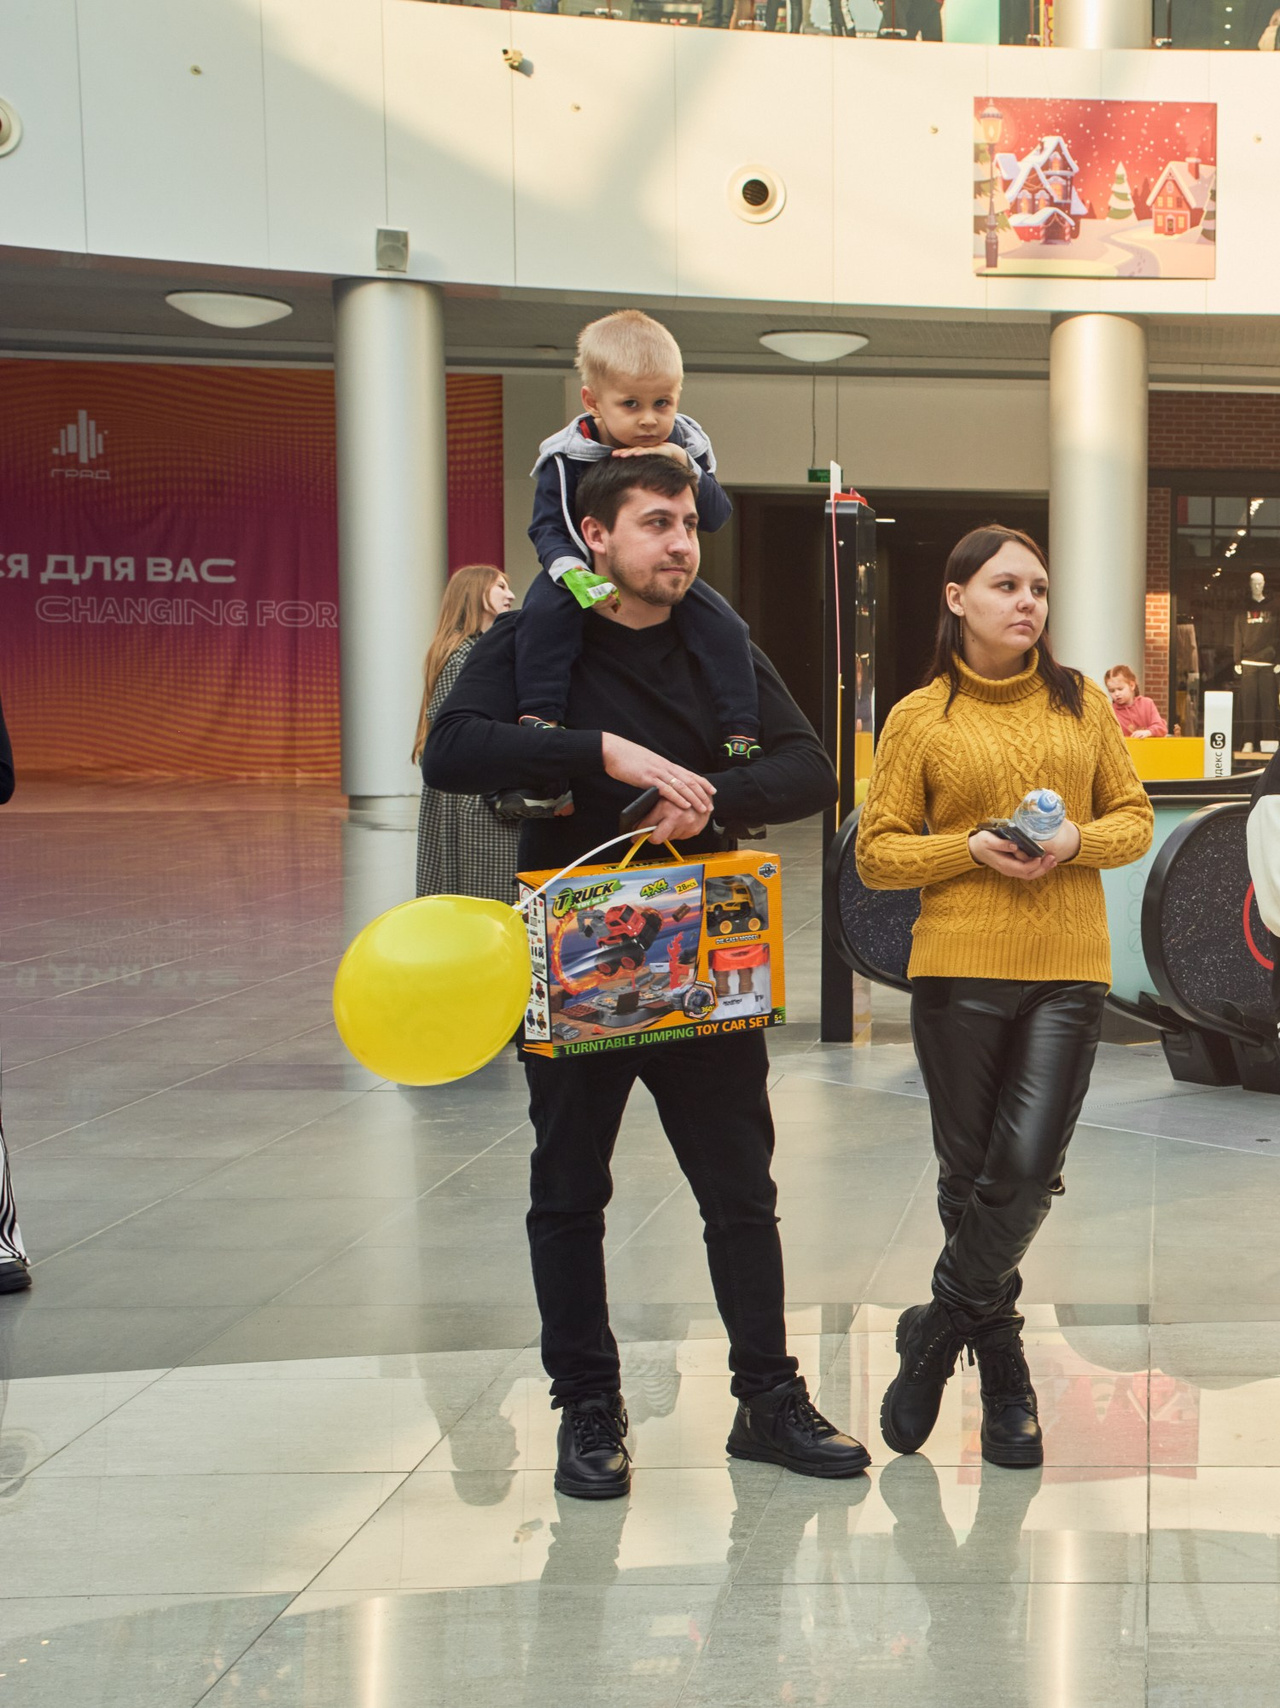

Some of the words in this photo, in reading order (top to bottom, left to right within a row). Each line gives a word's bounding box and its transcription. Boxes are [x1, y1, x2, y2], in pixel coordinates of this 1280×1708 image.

[0, 553, 29, 579] Я
[40, 554, 136, 585] ДЛЯ
[146, 557, 237, 583] ВАС
[35, 595, 248, 627] CHANGING
[256, 600, 338, 628] FOR
[1211, 733, 1225, 749] Go
[555, 881, 616, 912] TRUCK
[564, 1035, 636, 1055] TURNTABLE
[639, 1026, 694, 1045] JUMPING
[696, 1022, 719, 1036] TOY
[722, 1019, 746, 1032] CAR
[749, 1015, 769, 1029] SET
